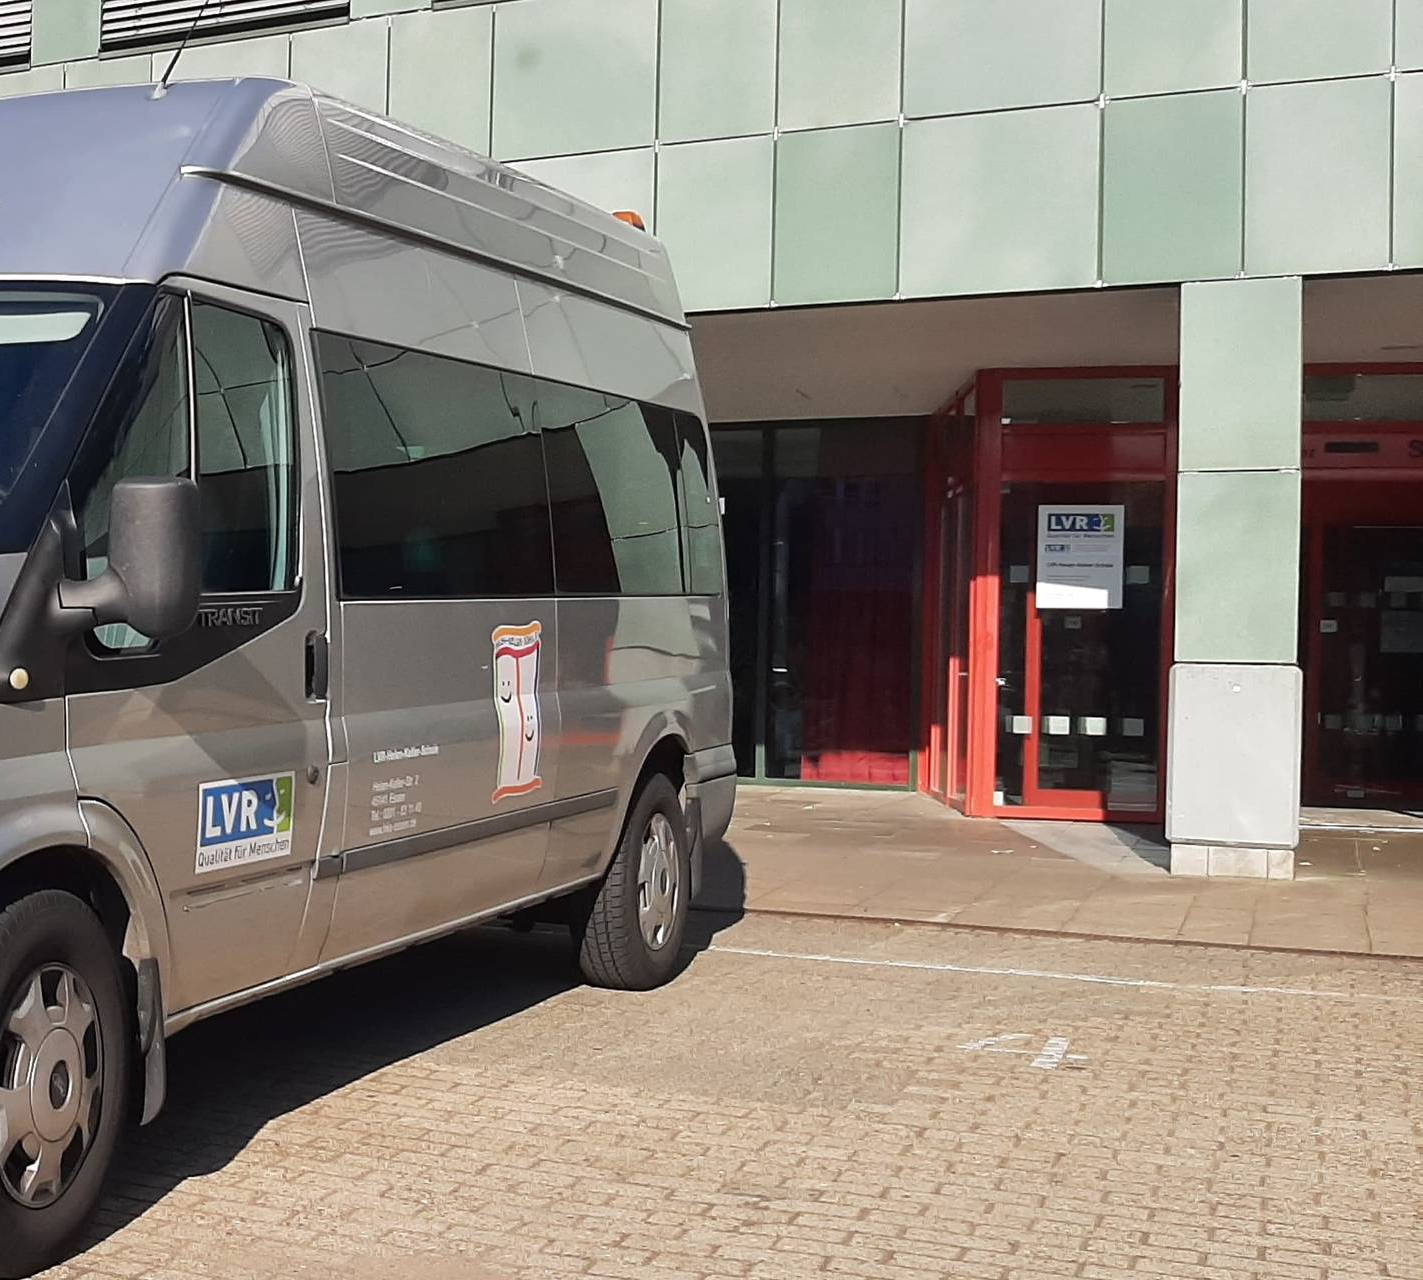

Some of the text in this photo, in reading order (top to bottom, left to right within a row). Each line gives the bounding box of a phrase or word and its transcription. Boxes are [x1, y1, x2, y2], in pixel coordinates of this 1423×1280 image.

[1050, 516, 1088, 530] LVR
[198, 607, 263, 627] TRANSIT
[205, 790, 258, 838] LVR
[198, 838, 289, 867] Qualität für Menschen
